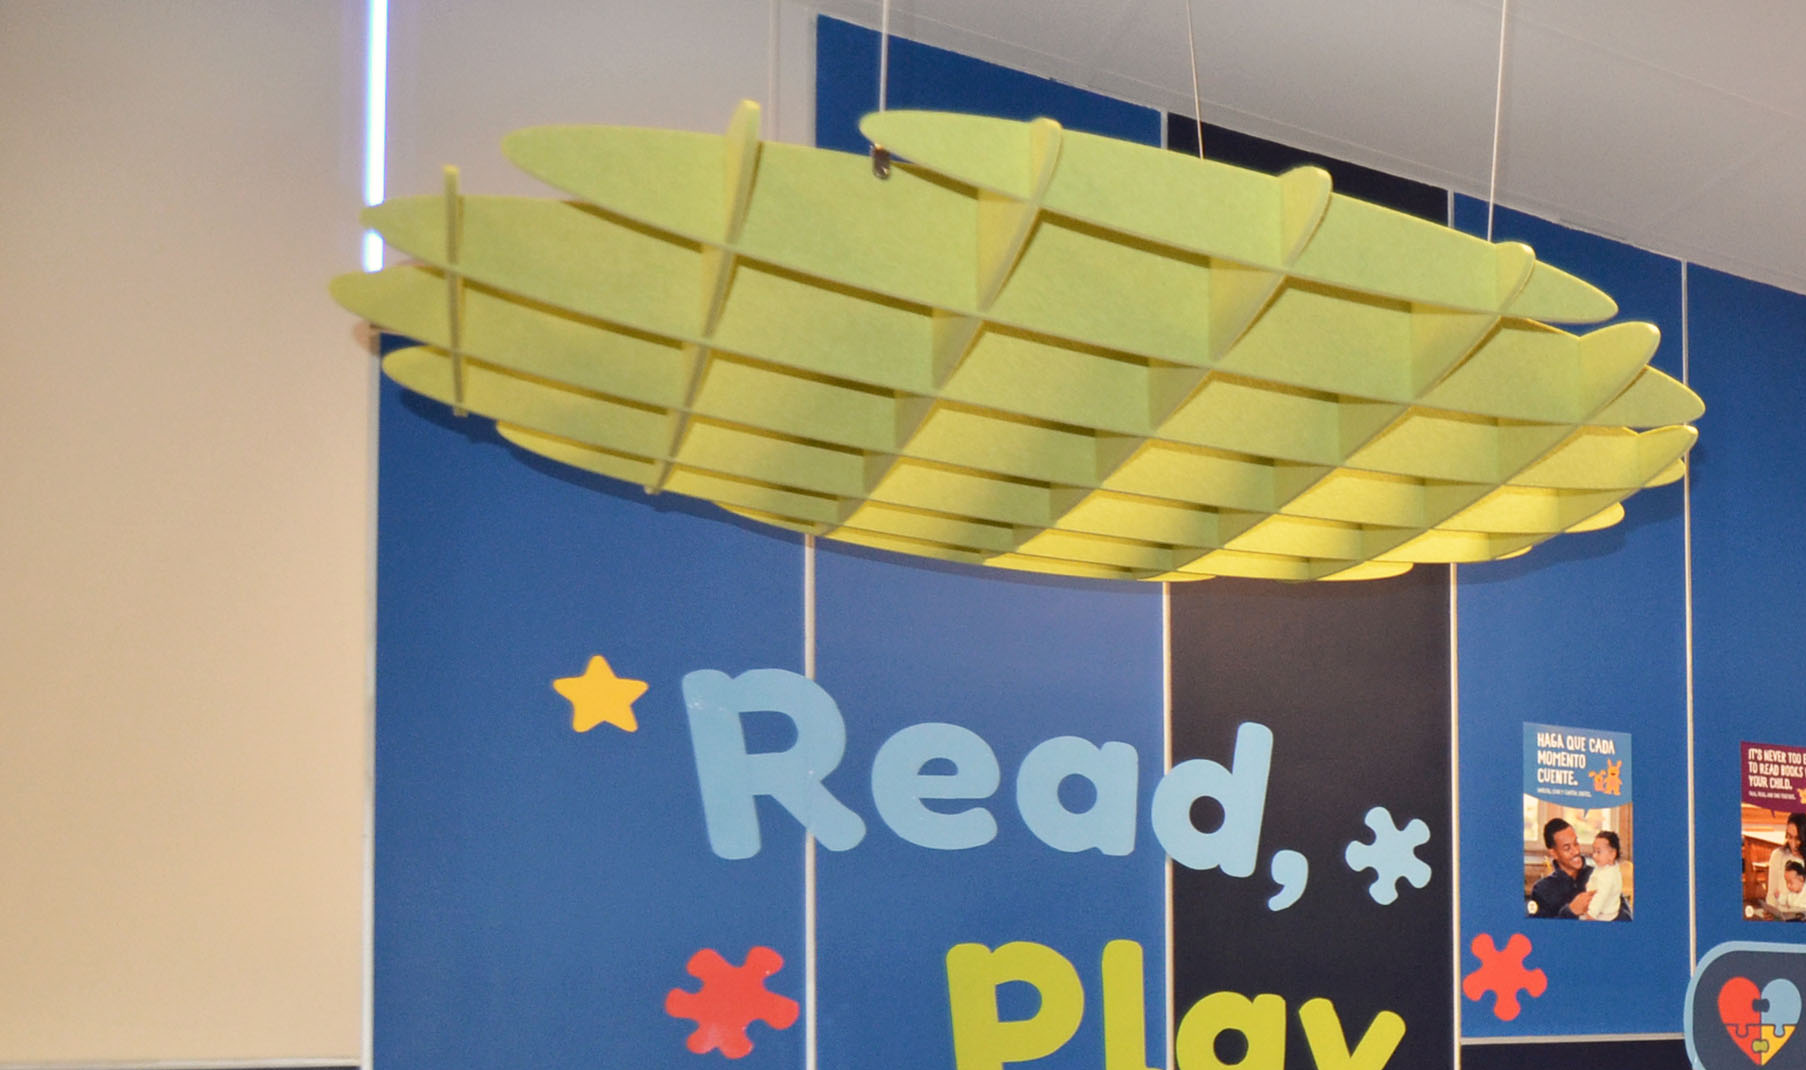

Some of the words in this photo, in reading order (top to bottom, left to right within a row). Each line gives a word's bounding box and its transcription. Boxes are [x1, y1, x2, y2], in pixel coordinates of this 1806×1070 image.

[1537, 732, 1565, 749] HAGA
[1566, 735, 1587, 752] QUE
[1589, 738, 1615, 755] CADA
[1537, 750, 1586, 769] MOMENTO
[1748, 748, 1763, 761] IT'S
[1764, 749, 1787, 764] NEVER
[1788, 751, 1802, 765] TOO
[1537, 768, 1578, 786] CUENTE.
[1748, 761, 1758, 774] TO
[1759, 763, 1779, 776] READ
[1781, 765, 1804, 778] BOOKS
[681, 668, 1308, 911] Read,
[1748, 774, 1768, 789] YOUR
[1769, 777, 1793, 790] CHILD.
